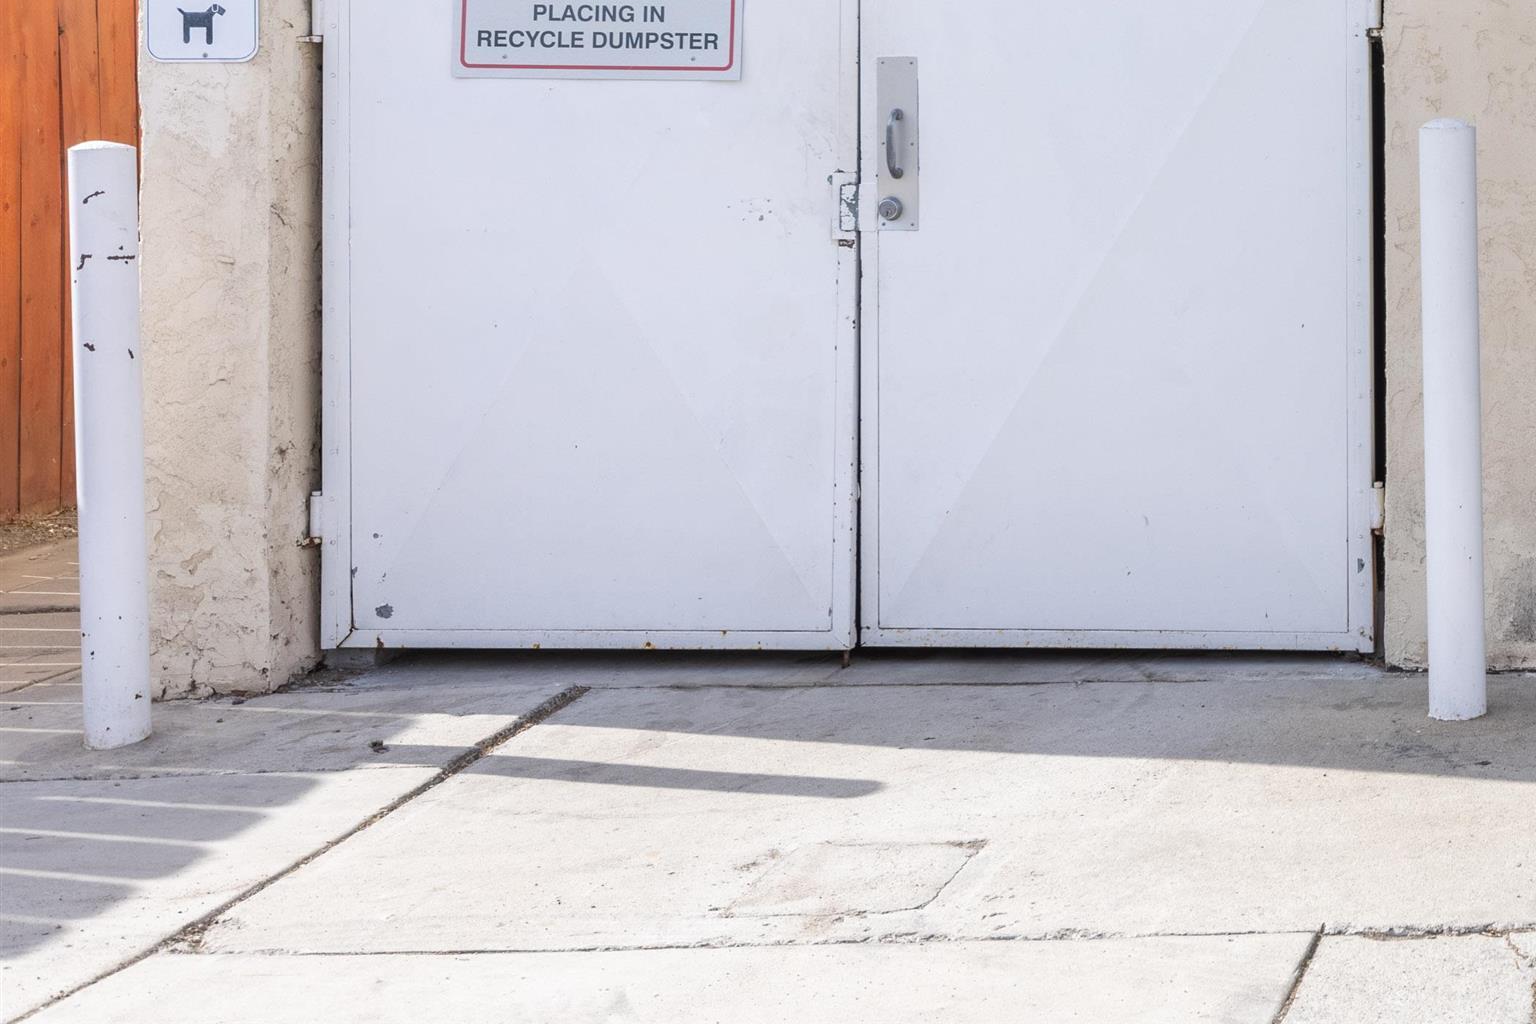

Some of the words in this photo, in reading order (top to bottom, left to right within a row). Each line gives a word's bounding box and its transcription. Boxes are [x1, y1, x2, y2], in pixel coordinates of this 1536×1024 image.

[533, 4, 635, 22] PLACING
[643, 5, 665, 23] IN
[477, 30, 584, 48] RECYCLE
[592, 32, 719, 50] DUMPSTER
